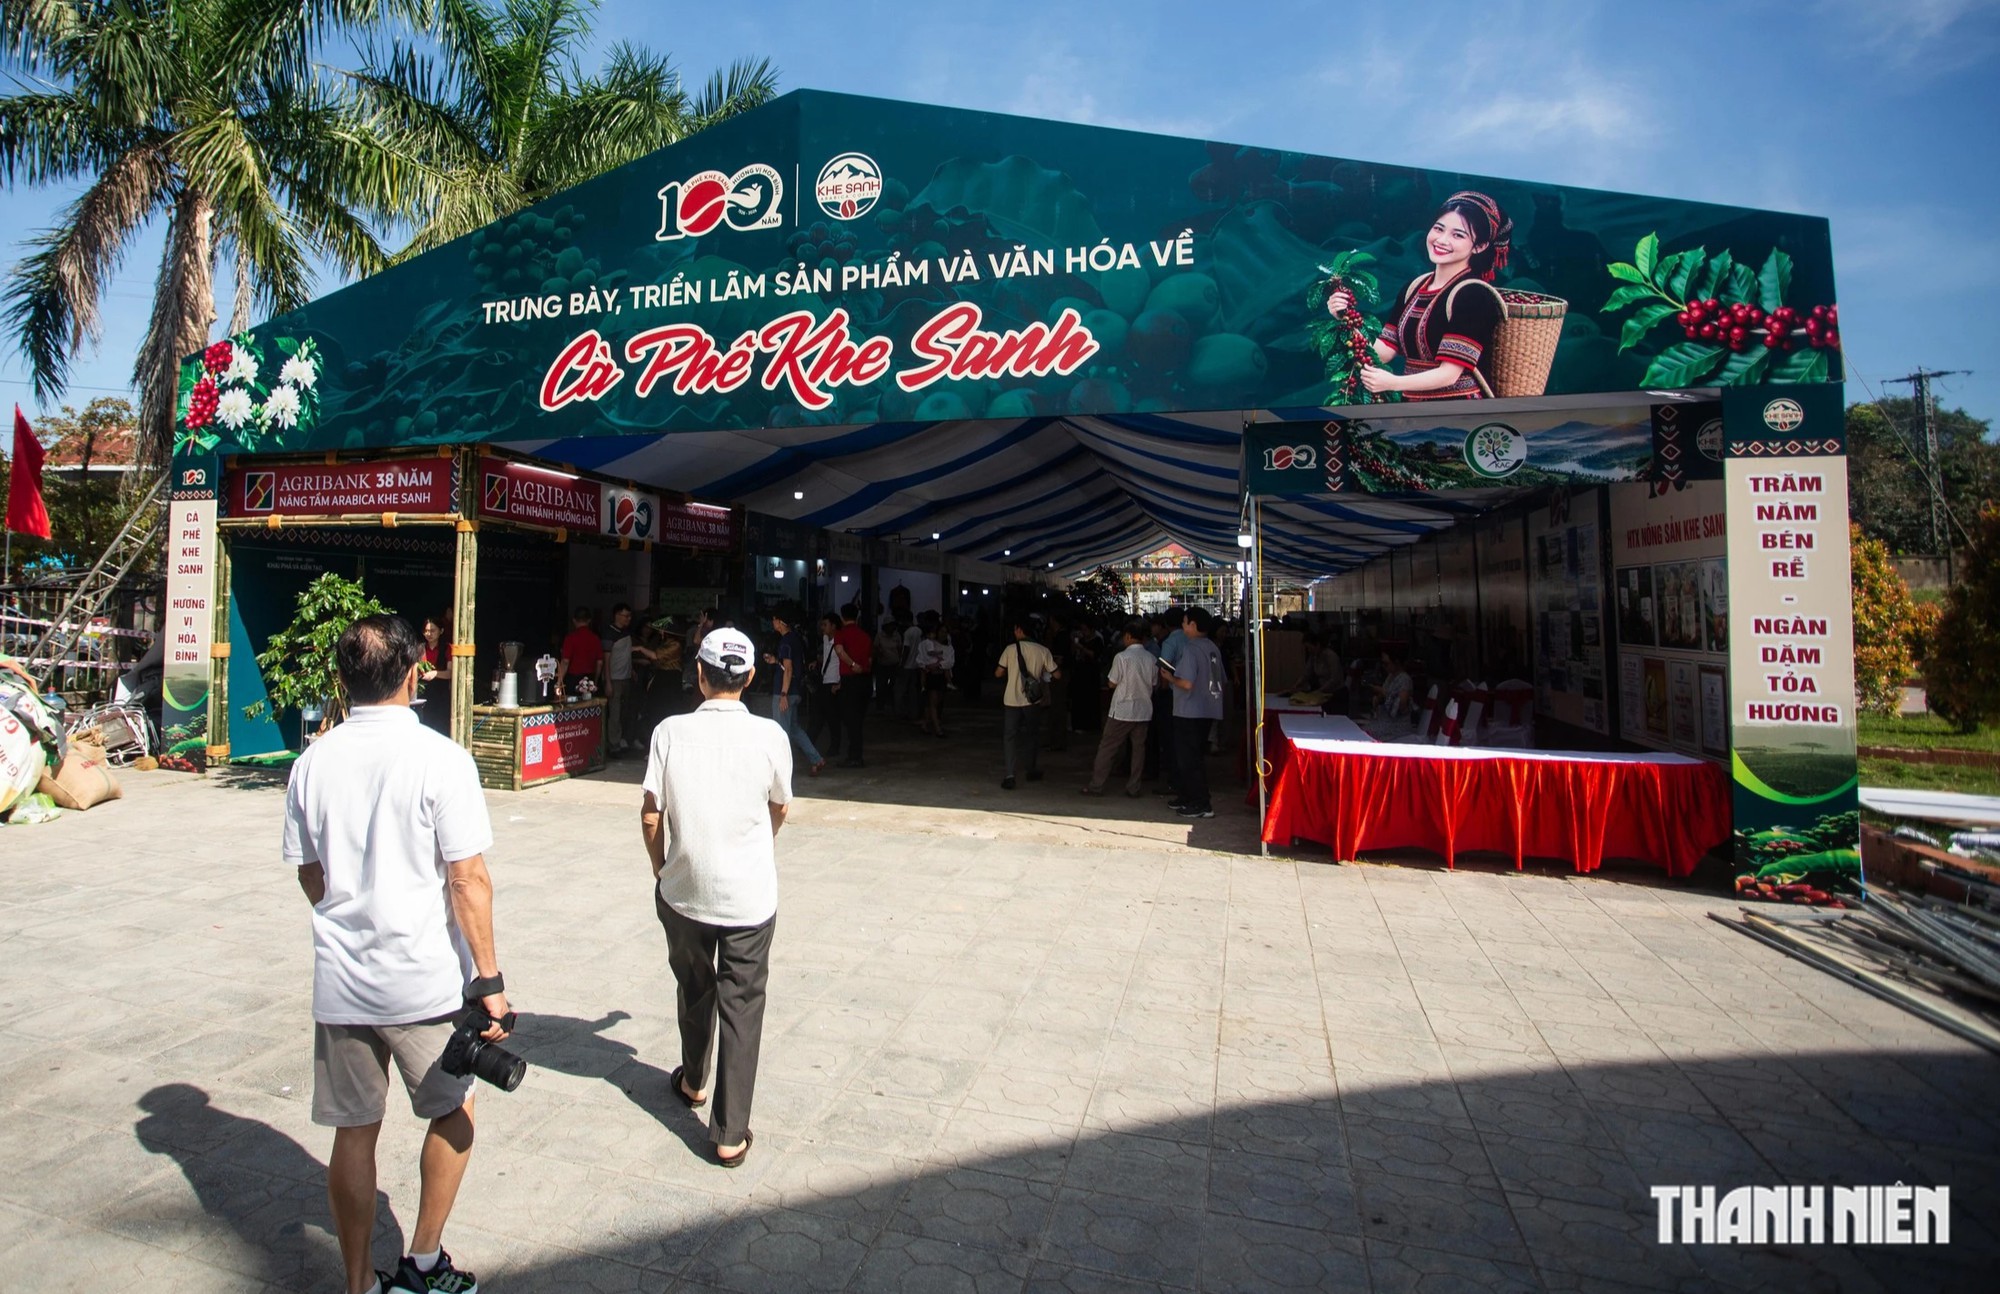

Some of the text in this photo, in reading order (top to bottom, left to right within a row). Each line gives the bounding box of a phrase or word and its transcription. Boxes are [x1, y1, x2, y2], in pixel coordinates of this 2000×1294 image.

[718, 175, 730, 191] SANH
[818, 181, 880, 196] KHE SANH
[762, 217, 778, 225] NĂM
[482, 228, 1194, 324] TRƯNG BÀY, TRIỂN LÃM SẢN PHẨM VÀ VĂN HÓA VỀ
[540, 301, 1100, 412] Cà Phê Khe Sanh
[280, 468, 432, 491] AGRIBANK 38 NĂM
[1749, 473, 1822, 492] TRĂM
[279, 494, 307, 506] NÂNG
[332, 494, 375, 506] ARABICA
[377, 493, 398, 504] KHE
[401, 492, 431, 504] SANH
[512, 480, 596, 512] AGRIBANK
[186, 511, 199, 522] CÀ
[511, 503, 524, 514] CHI
[526, 505, 554, 520] NHÁNH
[1757, 502, 1817, 520] NĂM
[666, 516, 706, 533] AGRIBANK
[1627, 529, 1640, 549] HTX
[1641, 522, 1662, 547] NÔNG
[1664, 515, 1681, 544] SẢN
[1683, 518, 1700, 542] KHE
[183, 528, 200, 540] PHÊ
[1762, 530, 1813, 549] BÉN
[182, 547, 200, 557] KHE
[178, 564, 203, 574] SANH
[1772, 556, 1804, 577] RỄ
[173, 598, 205, 609] HƯƠNG
[184, 616, 192, 628] VỊ
[1754, 616, 1827, 635] NGÀN
[175, 649, 198, 661] BÌNH
[1762, 644, 1820, 667] DẶM
[1767, 671, 1816, 692] TỎA
[1749, 703, 1838, 723] HƯƠNG
